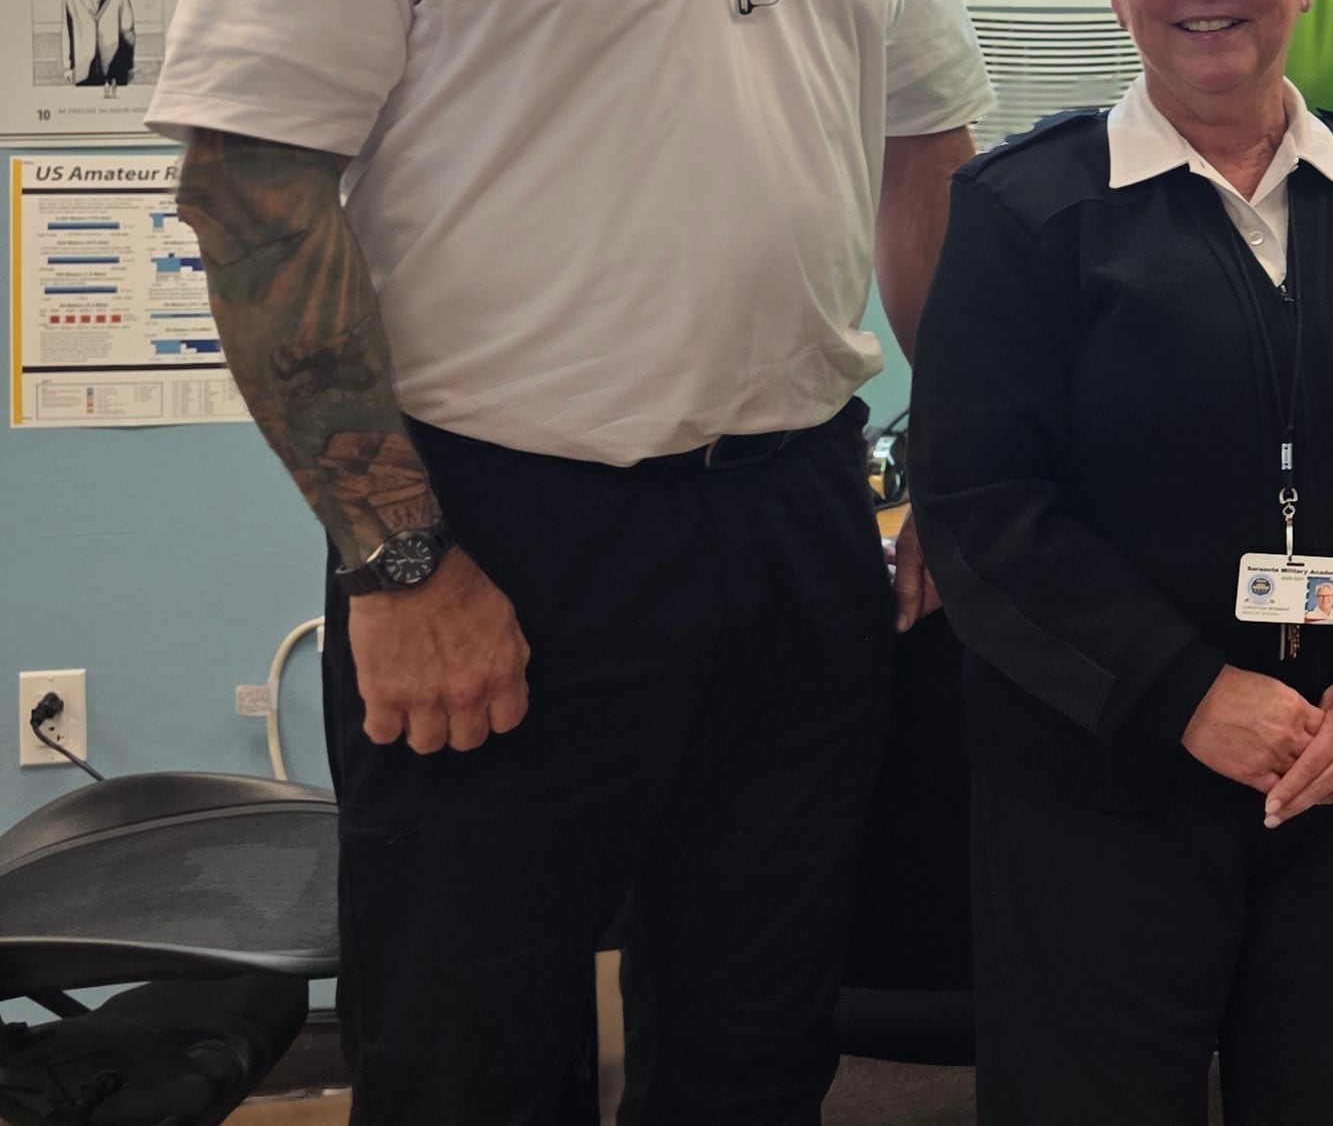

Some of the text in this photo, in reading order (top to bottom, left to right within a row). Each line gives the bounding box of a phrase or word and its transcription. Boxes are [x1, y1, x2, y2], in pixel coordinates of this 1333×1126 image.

[37, 109, 51, 121] 10
[35, 166, 64, 181] US
[68, 165, 160, 181] Amateur
